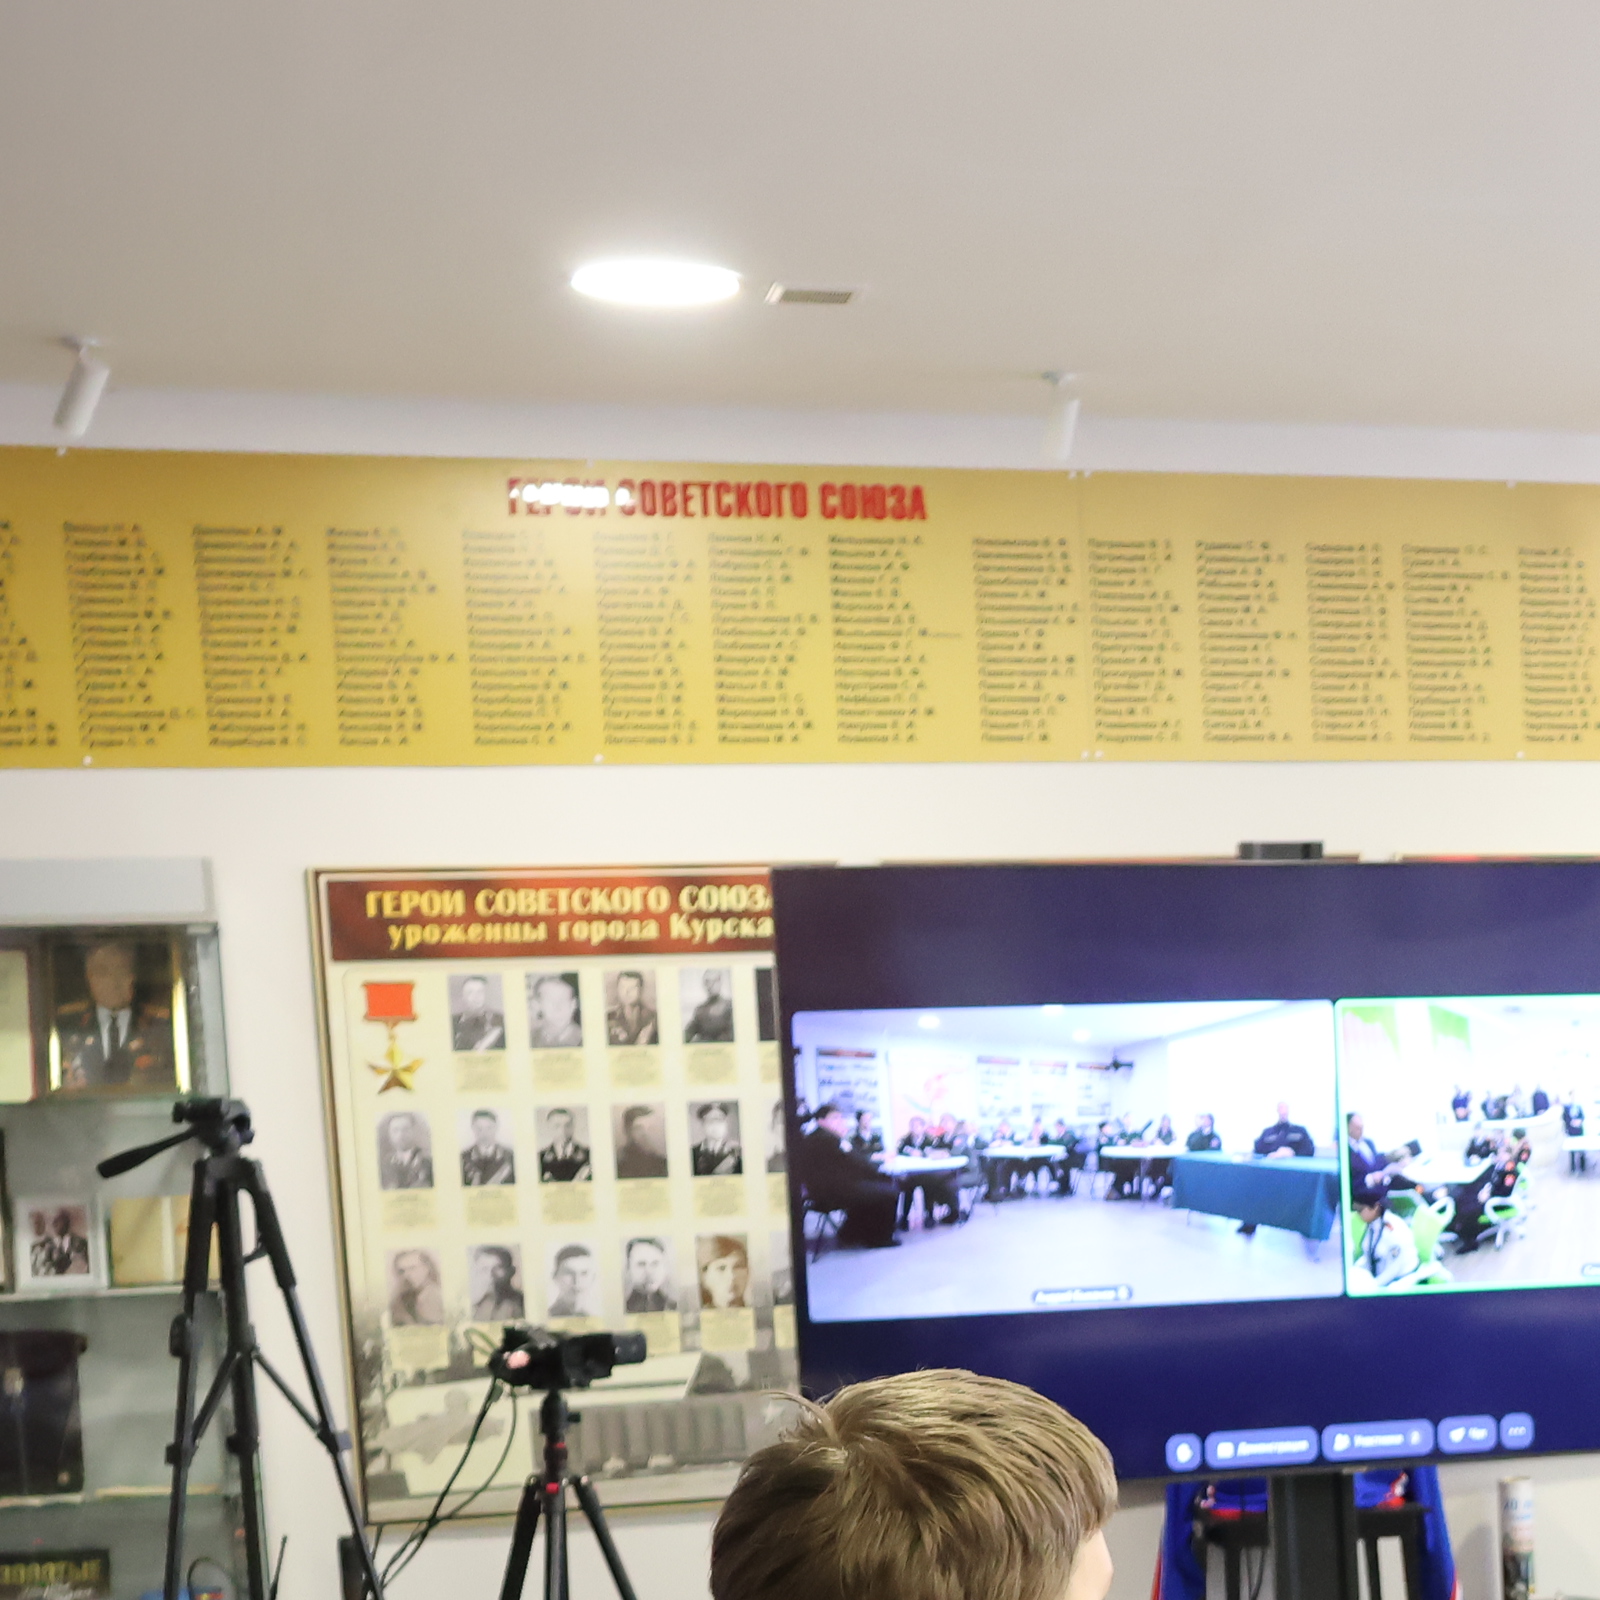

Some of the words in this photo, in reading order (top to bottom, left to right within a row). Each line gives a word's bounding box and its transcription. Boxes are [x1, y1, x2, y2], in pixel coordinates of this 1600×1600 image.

[617, 478, 809, 519] СОВЕТСКОГО
[819, 481, 927, 520] СОЮЗА
[365, 889, 466, 918] ГЕРОИ
[474, 886, 671, 917] СОВЕТСКОГО
[678, 883, 772, 914] СОЮЗ
[388, 919, 548, 951] уроженцы
[558, 918, 659, 946] города
[669, 911, 774, 944] Курска
